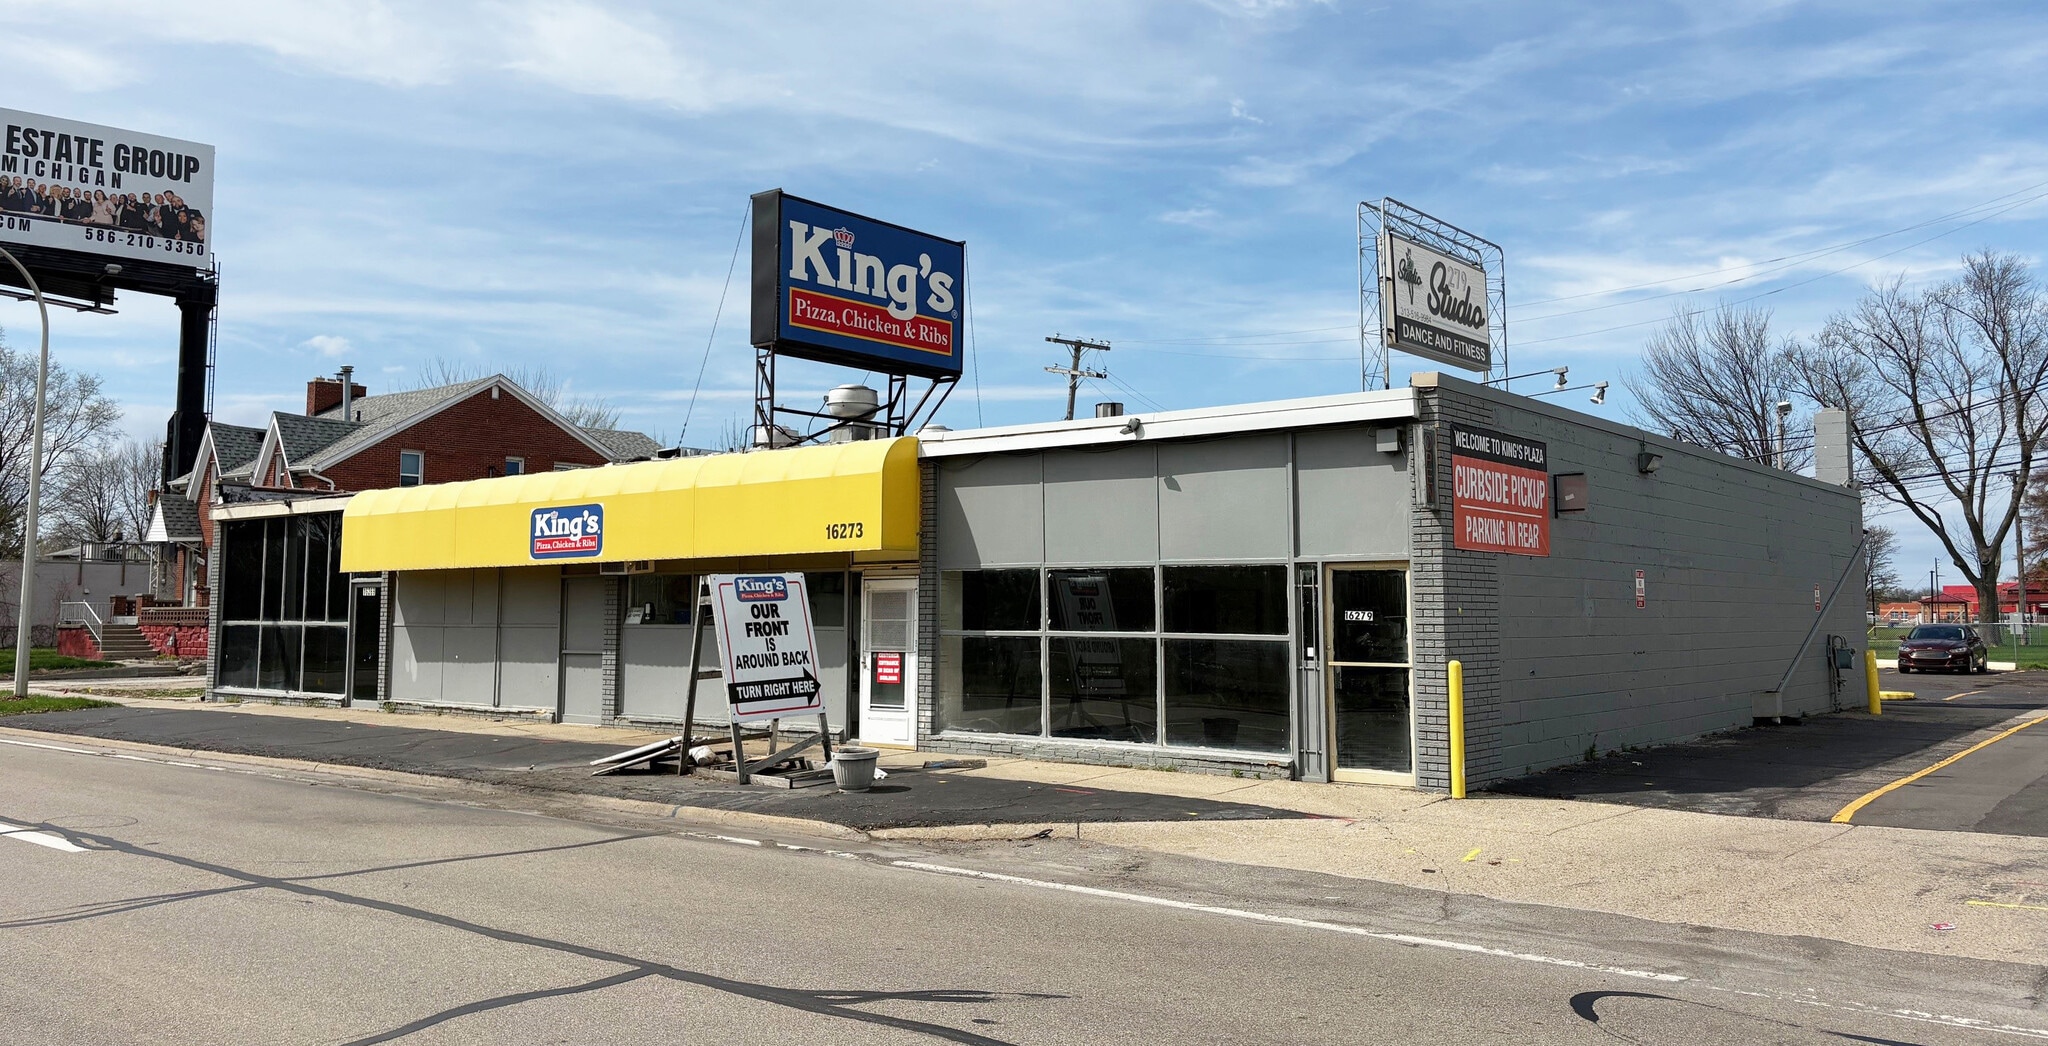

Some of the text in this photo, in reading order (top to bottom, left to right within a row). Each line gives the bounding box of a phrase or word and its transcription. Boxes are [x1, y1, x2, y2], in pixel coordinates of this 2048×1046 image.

[6, 124, 200, 184] ESTATE GROUP
[1, 154, 122, 189] MICHIGAN
[85, 227, 204, 257] 586-210-3350
[789, 219, 954, 321] King's
[1427, 261, 1485, 330] Studio
[795, 297, 948, 346] Pizza, Chicken & Ribs
[1402, 323, 1486, 361] DANCE AND FITNESS
[1454, 430, 1544, 464] WELCOME TO KING'S PLAZA
[1454, 464, 1546, 510] CURBSIDE PICKUP
[534, 509, 599, 541] King's
[825, 522, 864, 540] 16273
[1465, 515, 1540, 549] PARKING IN REAR
[552, 540, 575, 549] Chicken
[582, 539, 596, 547] Ribs
[737, 578, 785, 594] King's
[751, 603, 781, 619] OUR
[1345, 611, 1373, 621] 16279
[745, 620, 790, 638] FRONT
[765, 637, 776, 652] IS
[736, 650, 810, 670] AROUND BACK
[736, 680, 816, 699] TURN RIGHT HERE
